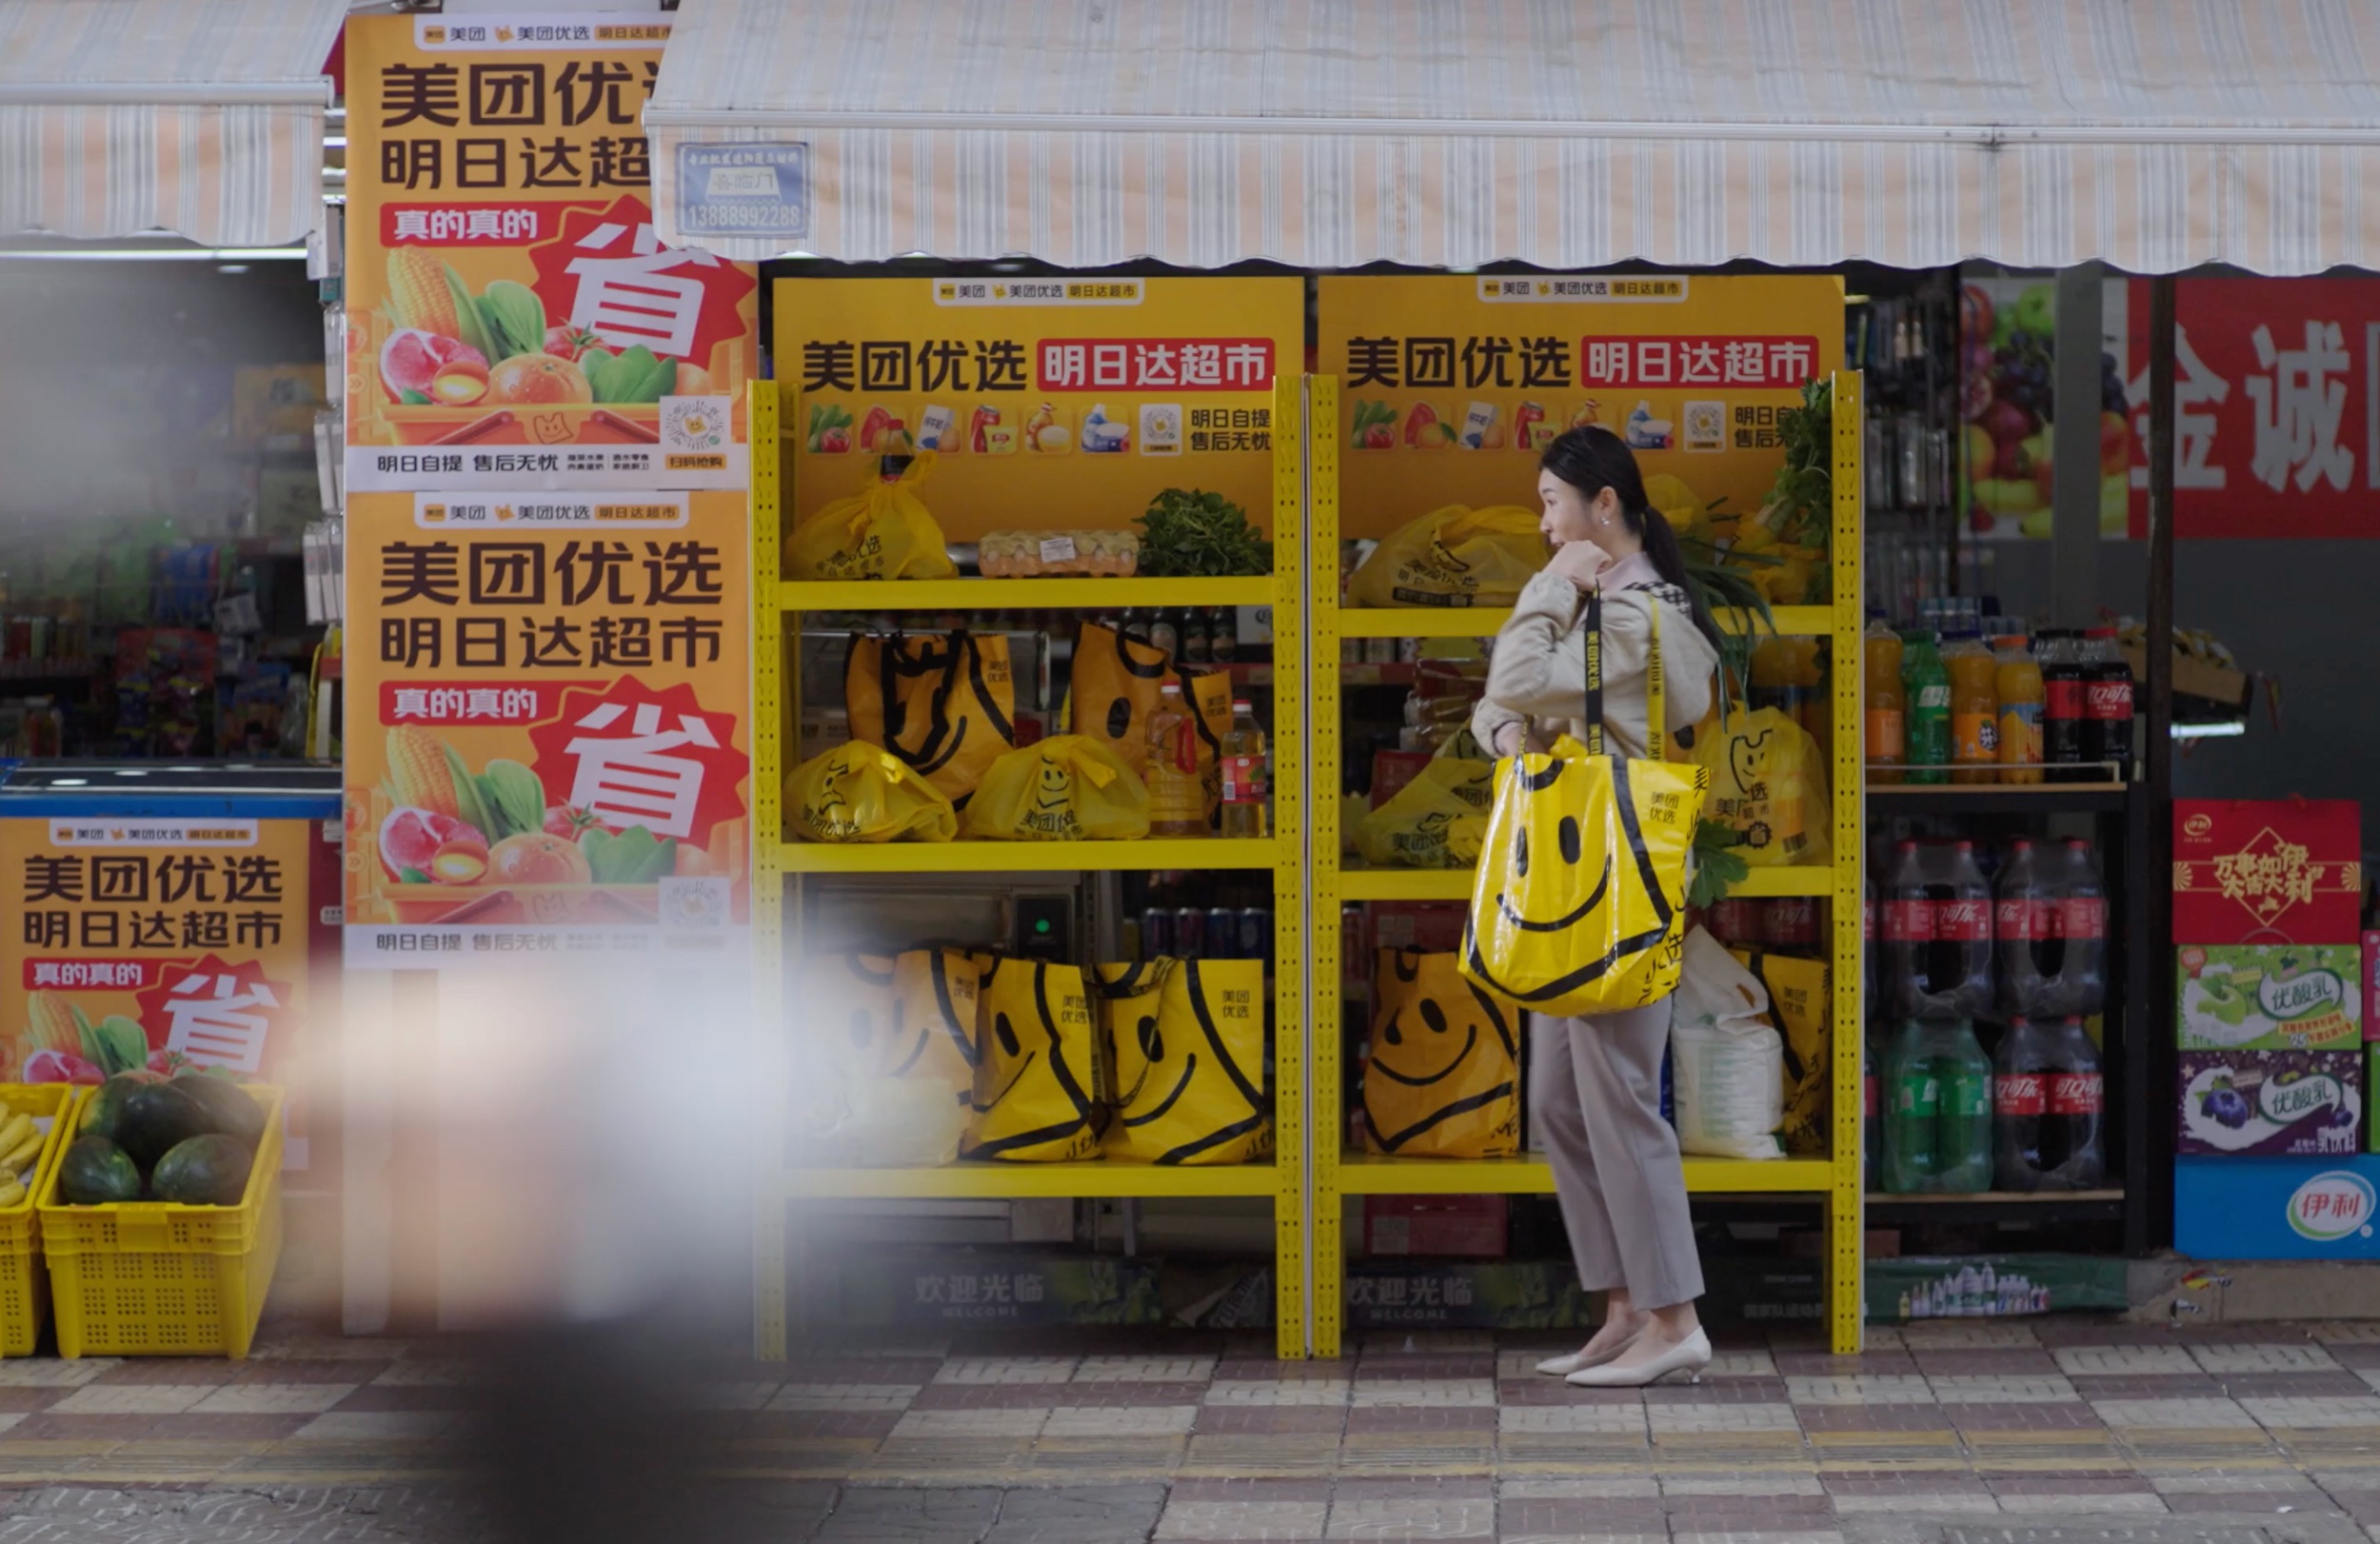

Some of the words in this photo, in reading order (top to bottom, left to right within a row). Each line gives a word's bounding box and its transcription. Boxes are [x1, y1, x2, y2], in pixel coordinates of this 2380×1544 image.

[450, 27, 486, 42] 美团
[517, 26, 590, 41] 美团优选
[381, 61, 659, 128] 美团优
[394, 209, 538, 240] 真的真的
[689, 205, 800, 227] 13888992288
[564, 222, 722, 358] 省
[959, 285, 985, 298] 美团
[1009, 285, 1063, 298] 美团优选
[1069, 285, 1136, 297] 明日达超市
[1503, 282, 1530, 295] 美团
[1554, 282, 1607, 295] 美团优选
[1614, 283, 1679, 295] 明日达超市
[803, 340, 1026, 393] 美团优选
[1044, 344, 1267, 387] 明日达超市
[1347, 335, 1571, 388] 美团优选
[1589, 341, 1812, 385] 明日达超市
[1735, 406, 1804, 425] 明日
[2125, 320, 2380, 493] 金诚
[1192, 409, 1271, 428] 明日自提
[1192, 433, 1272, 452] 售后无忧
[378, 454, 463, 473] 明日自提
[474, 454, 559, 472] 售后无忧
[450, 505, 486, 521] 美团
[517, 505, 590, 521] 美团优选
[599, 505, 677, 520] 明日达超市
[381, 541, 723, 606] 美团优选
[381, 616, 724, 668] 明日达超市
[393, 688, 538, 719] 真的真的
[564, 702, 722, 838] 省
[1652, 791, 1680, 808] 美团
[1650, 807, 1676, 825] 优选
[77, 829, 104, 840] 美团
[129, 828, 183, 840] 美团优选
[189, 829, 248, 840] 明日达超市
[24, 855, 283, 903] 美团优选
[24, 911, 283, 949] 明日达超市
[376, 933, 462, 952] 明日自提
[473, 933, 558, 952] 售后无忧
[33, 962, 143, 986] 真的真的
[1062, 995, 1087, 1009] 美团
[1222, 989, 1249, 1004] 美团
[2272, 975, 2332, 1011] 优酸乳
[1061, 1009, 1087, 1024] 优选
[1222, 1004, 1249, 1019] 优选
[162, 973, 281, 1074] 省
[2272, 1078, 2332, 1115] 优酸乳
[2301, 1193, 2362, 1219] 伊利
[914, 1274, 1044, 1303] 欢迎光临
[1347, 1276, 1473, 1306] 欢迎光临
[942, 1306, 1019, 1317] WELCOME
[1371, 1309, 1446, 1320] WELCOME
